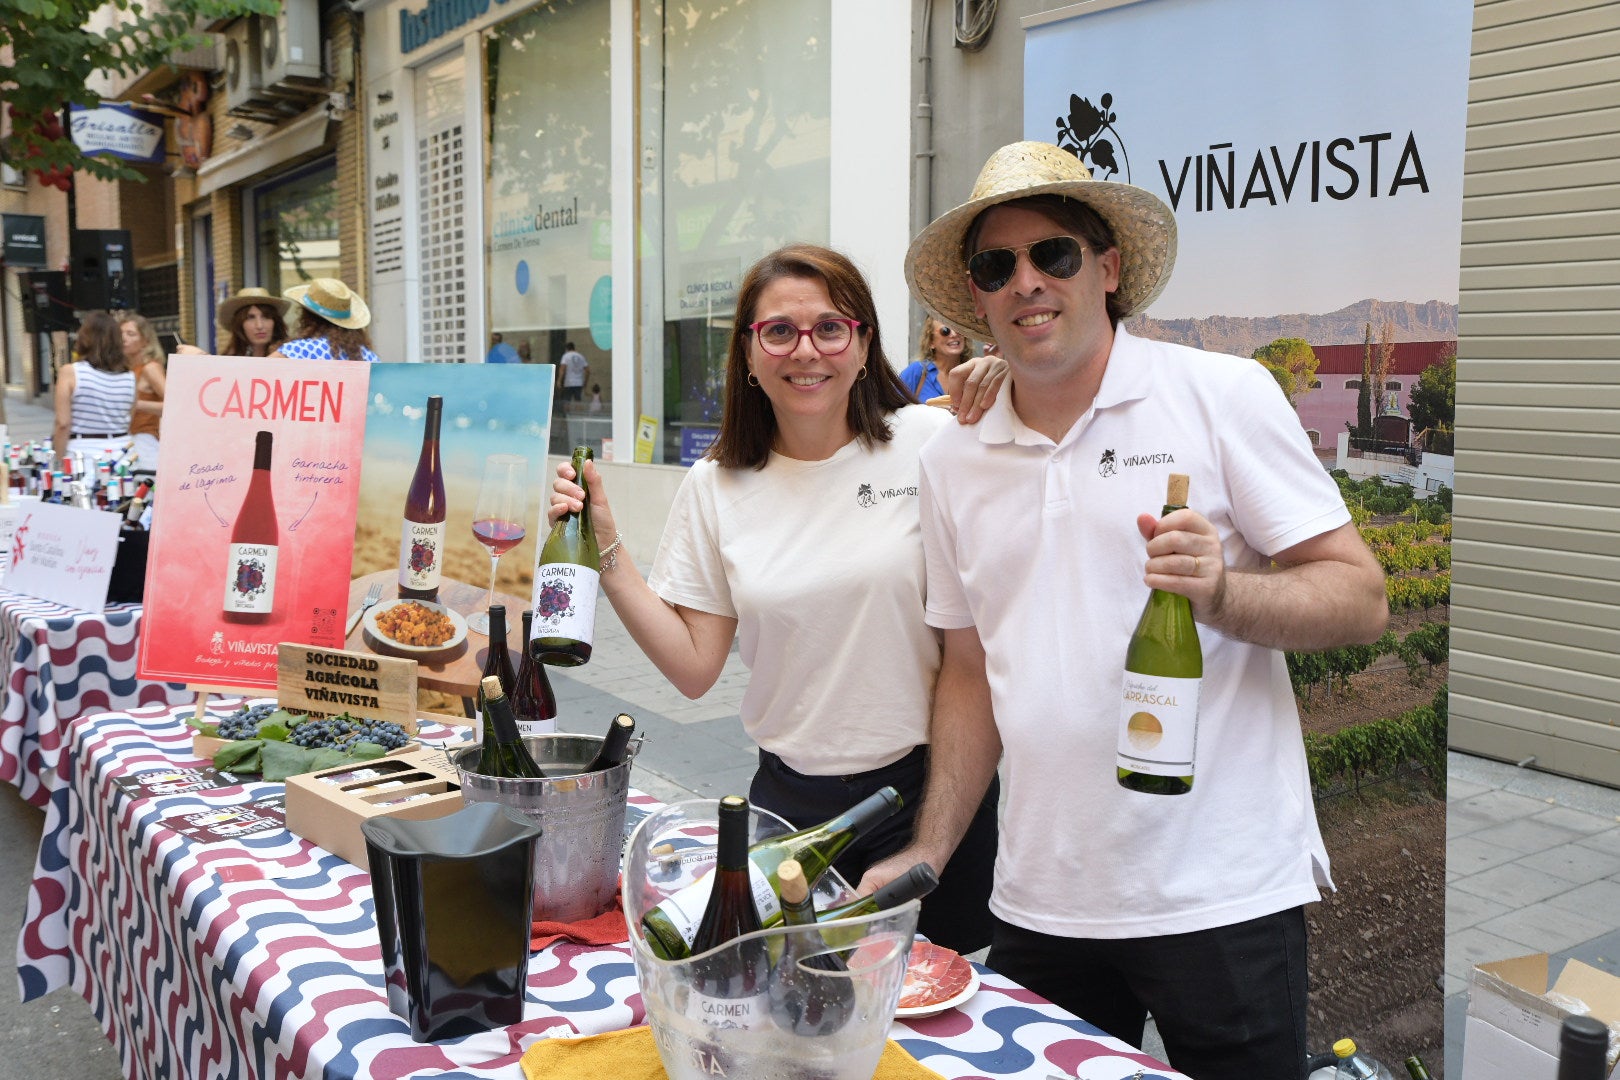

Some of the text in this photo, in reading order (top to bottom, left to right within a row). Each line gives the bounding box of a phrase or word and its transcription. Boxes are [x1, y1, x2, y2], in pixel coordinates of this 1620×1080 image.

[1158, 129, 1430, 213] VIÑAVISTA
[199, 376, 344, 423] CARMEN
[292, 458, 349, 470] Garnacha
[1122, 453, 1175, 467] VIÑAVISTA
[188, 464, 224, 475] Rosado
[179, 482, 191, 490] de
[295, 475, 344, 484] tintorera
[412, 526, 437, 536] CARMEN
[238, 547, 268, 556] CARMEN
[541, 567, 576, 577] CARMEN
[227, 640, 279, 655] VIÑAVISTA
[195, 655, 223, 667] Bodega
[224, 660, 231, 668] y
[306, 652, 379, 672] SOCIEDAD
[305, 669, 379, 690] AGRÍCOLA
[304, 687, 379, 708] VIÑAVISTA
[702, 1001, 750, 1017] CARMEN
